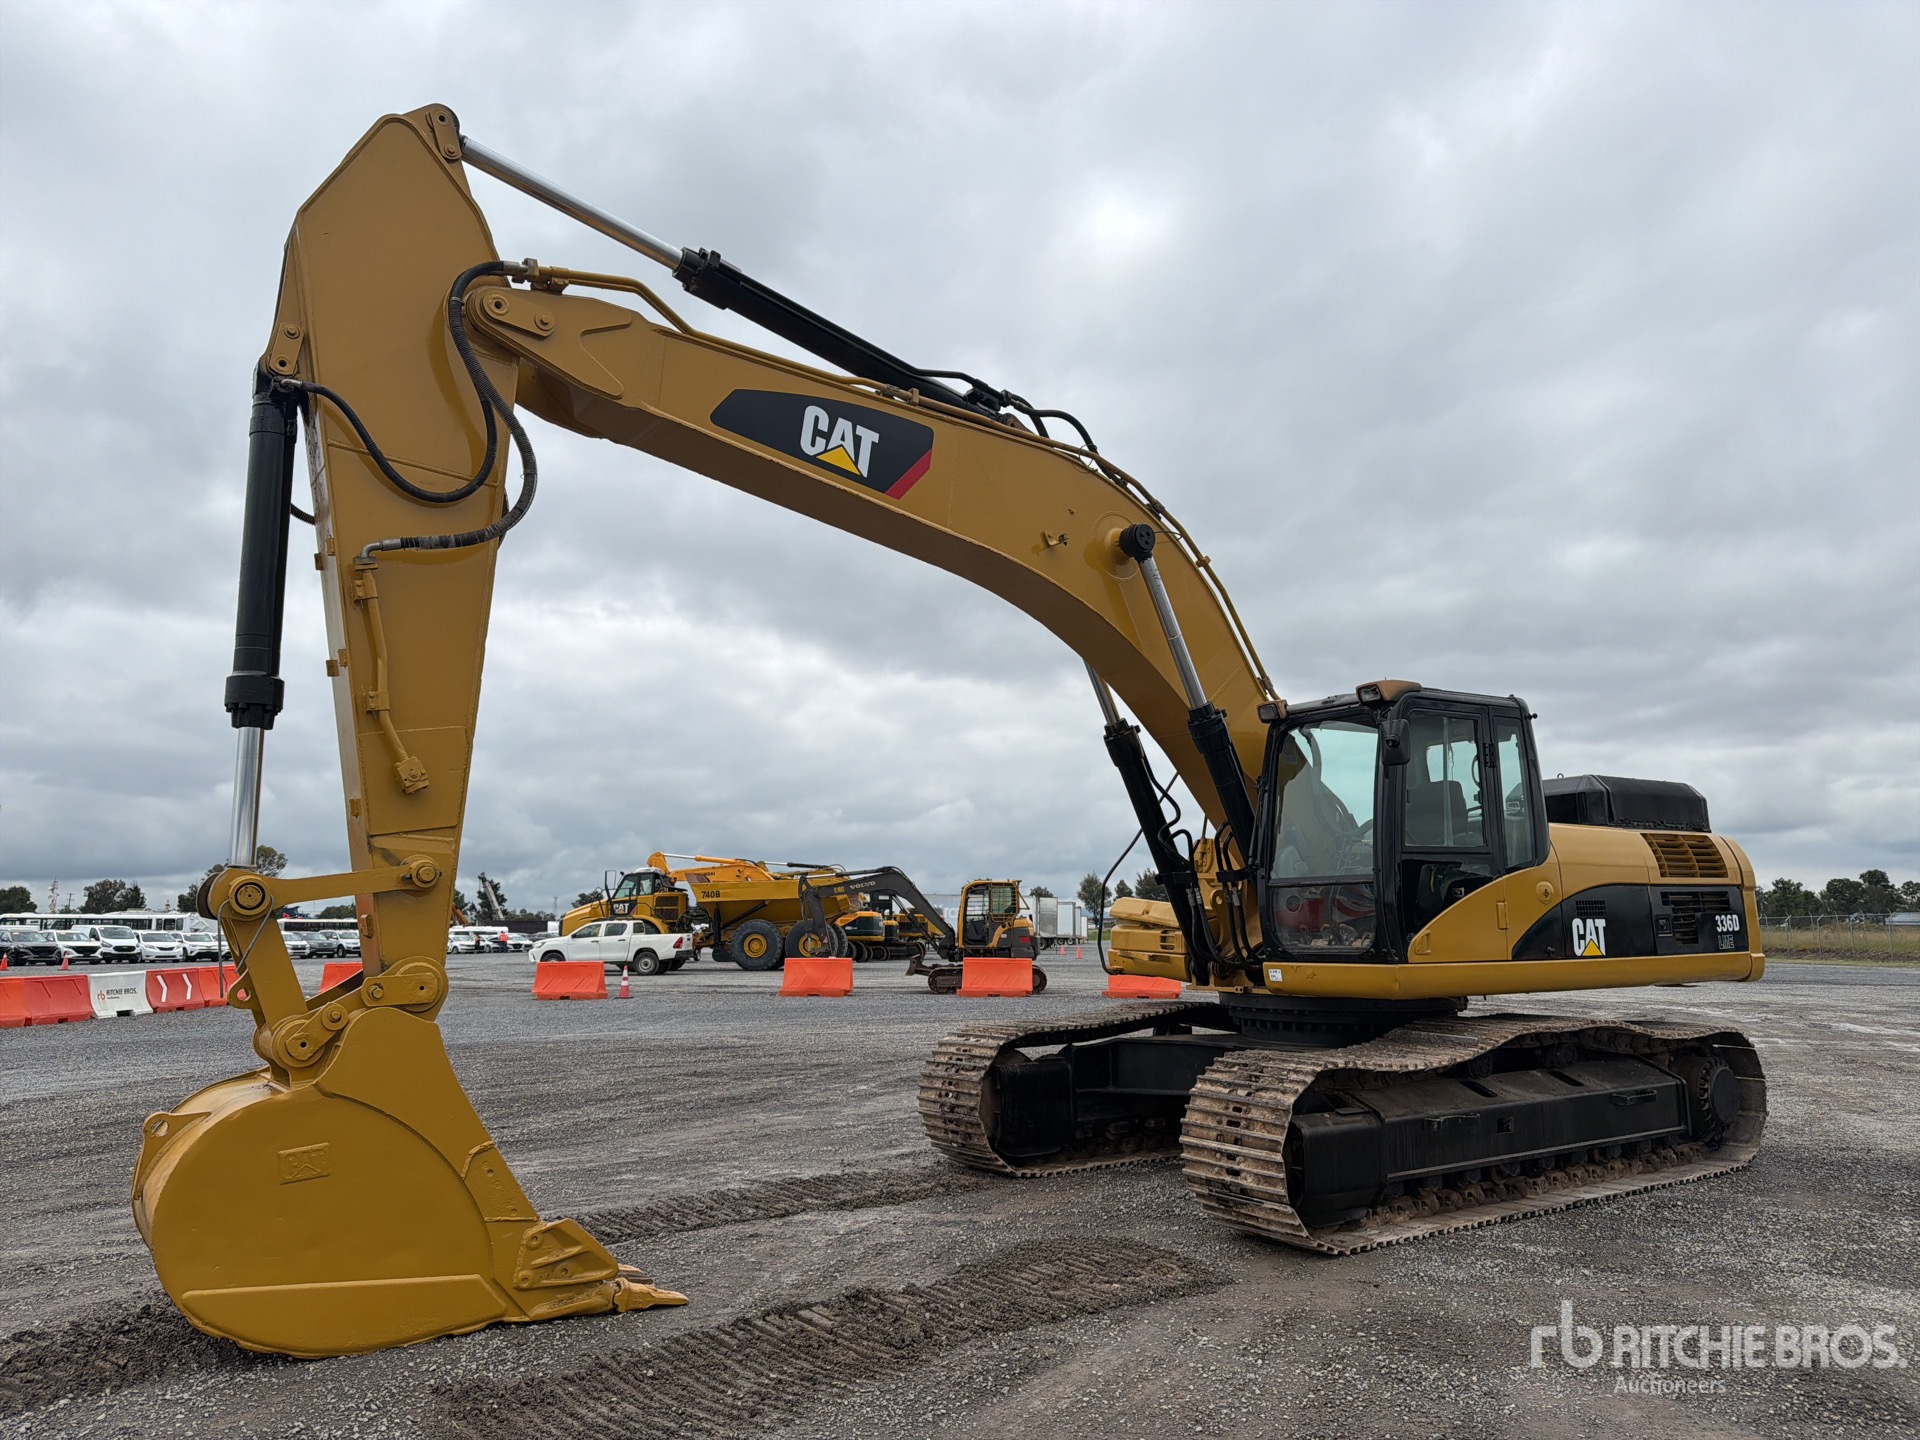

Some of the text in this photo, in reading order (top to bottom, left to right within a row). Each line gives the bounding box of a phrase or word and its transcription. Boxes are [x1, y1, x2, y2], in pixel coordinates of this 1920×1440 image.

[800, 405, 880, 478] CAT
[849, 881, 876, 889] VOLVO
[701, 890, 721, 899] 740B
[613, 903, 630, 914] CAT
[1715, 914, 1740, 932] 336D
[1572, 917, 1607, 957] CAT
[106, 988, 123, 996] RITCHIE
